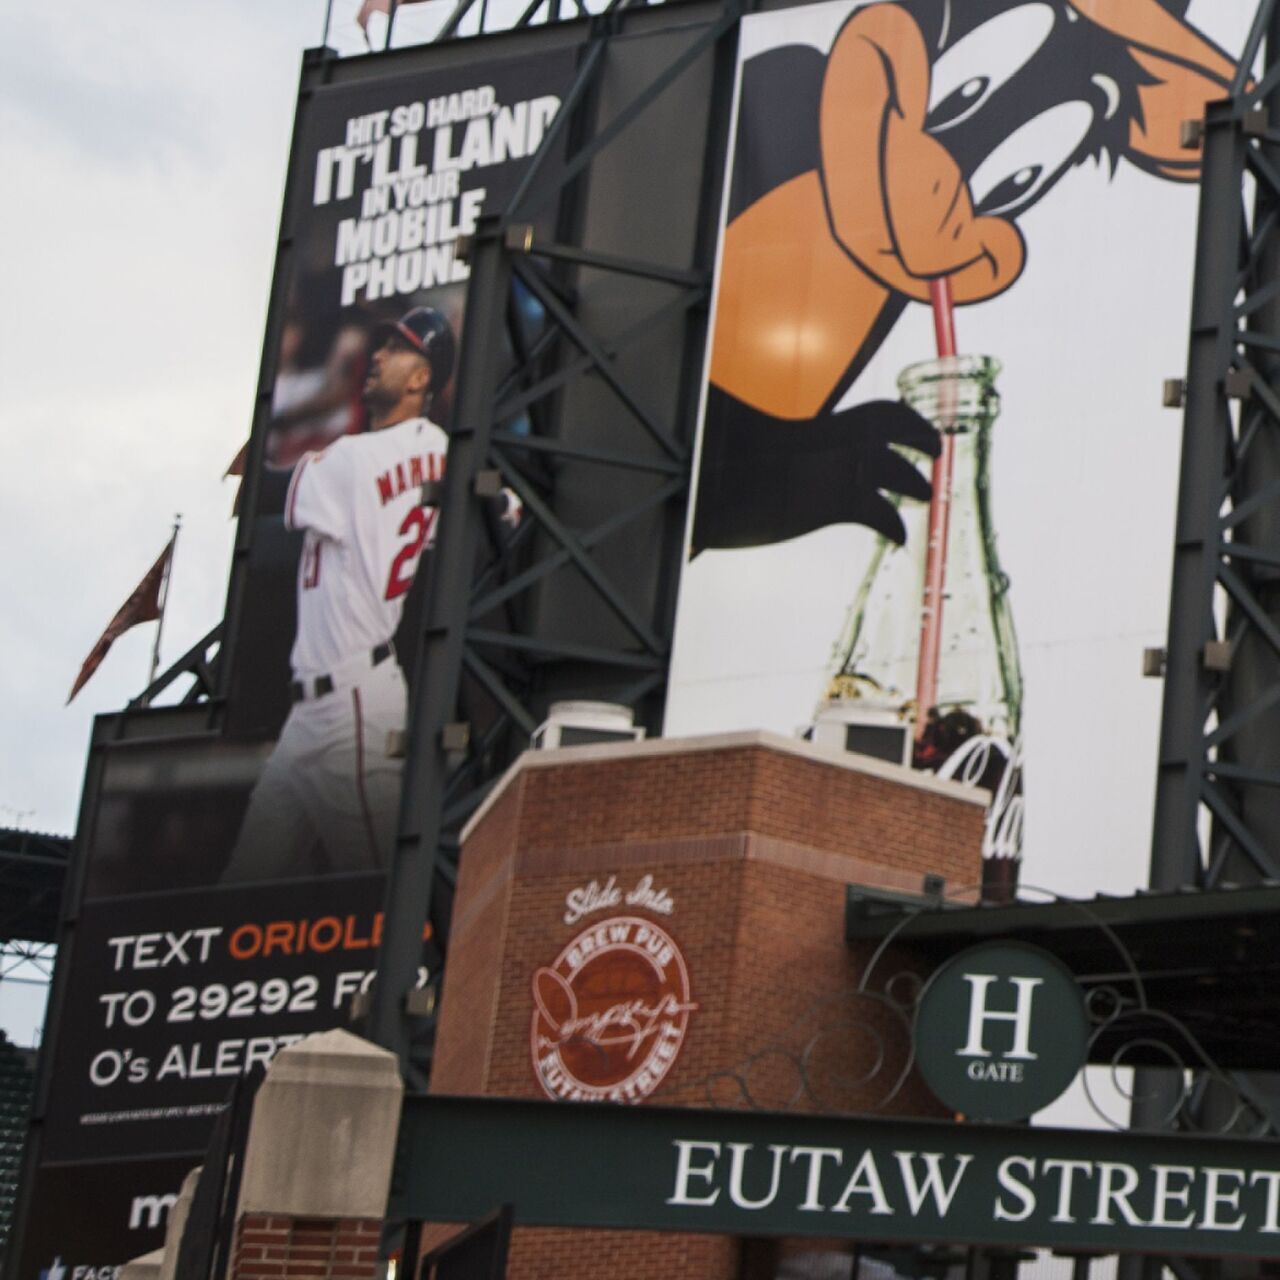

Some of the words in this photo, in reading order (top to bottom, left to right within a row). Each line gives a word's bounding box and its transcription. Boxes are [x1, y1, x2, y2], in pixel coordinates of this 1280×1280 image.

[346, 110, 389, 148] HIT
[390, 102, 425, 138] SO
[426, 86, 499, 129] HARD,
[313, 135, 427, 206] IT'LL
[432, 95, 561, 173] LAND
[361, 187, 389, 219] IN
[392, 170, 460, 211] YOUR
[335, 188, 486, 266] MOBILE
[108, 927, 223, 971] TEXT
[229, 911, 432, 960] ORIOL
[99, 990, 157, 1028] TO
[166, 974, 320, 1023] 29292
[955, 973, 1045, 1061] H
[89, 1048, 150, 1087] O's
[156, 1031, 325, 1082] ALER
[967, 1060, 1024, 1083] GATE
[665, 1138, 974, 1219] EUTAW
